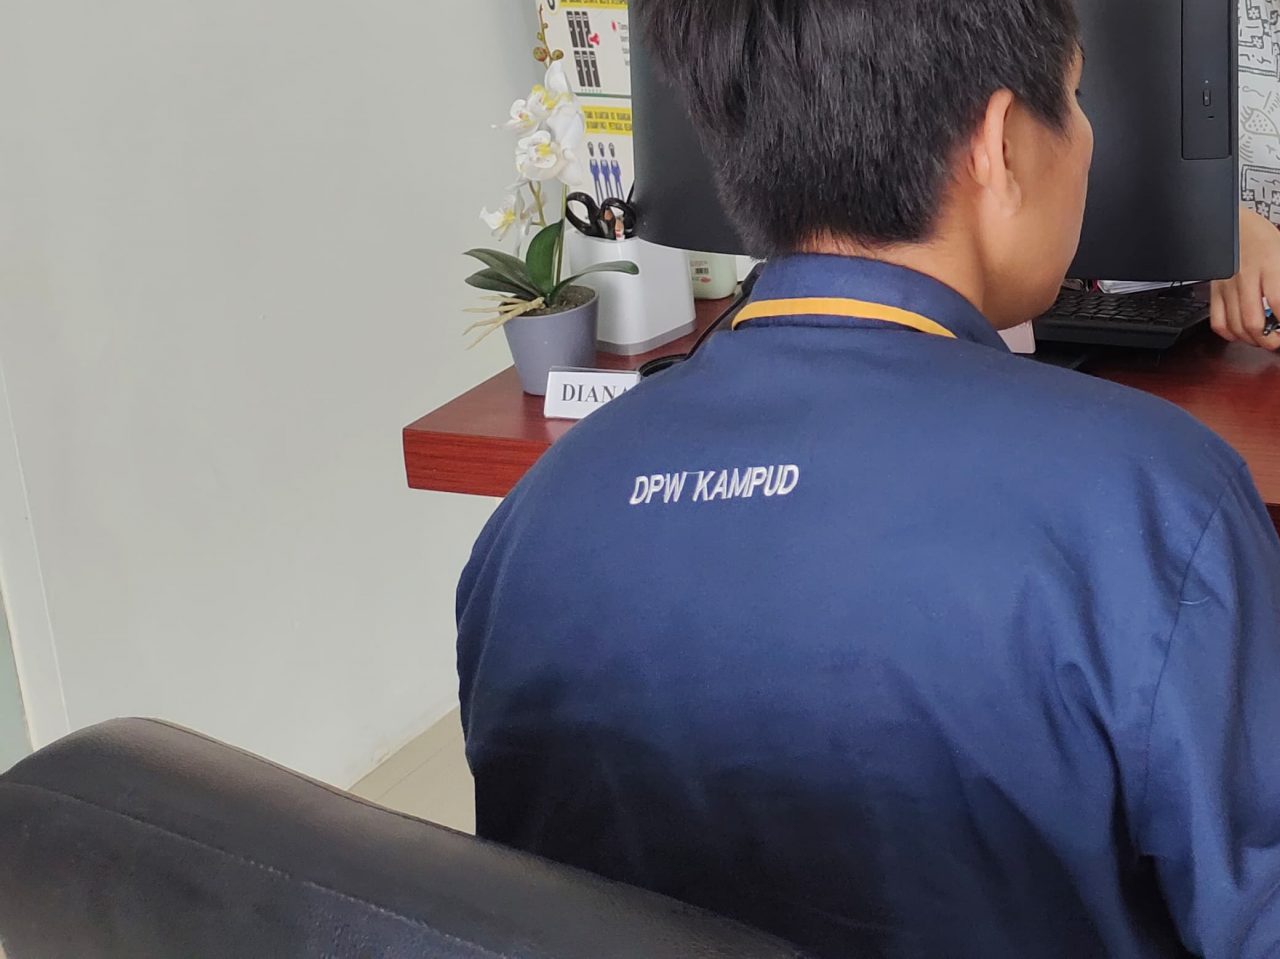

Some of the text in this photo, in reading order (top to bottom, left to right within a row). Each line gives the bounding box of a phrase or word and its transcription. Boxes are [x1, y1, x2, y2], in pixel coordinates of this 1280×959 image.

[562, 383, 628, 403] DIAN
[629, 464, 799, 505] DPW KAMPUD
